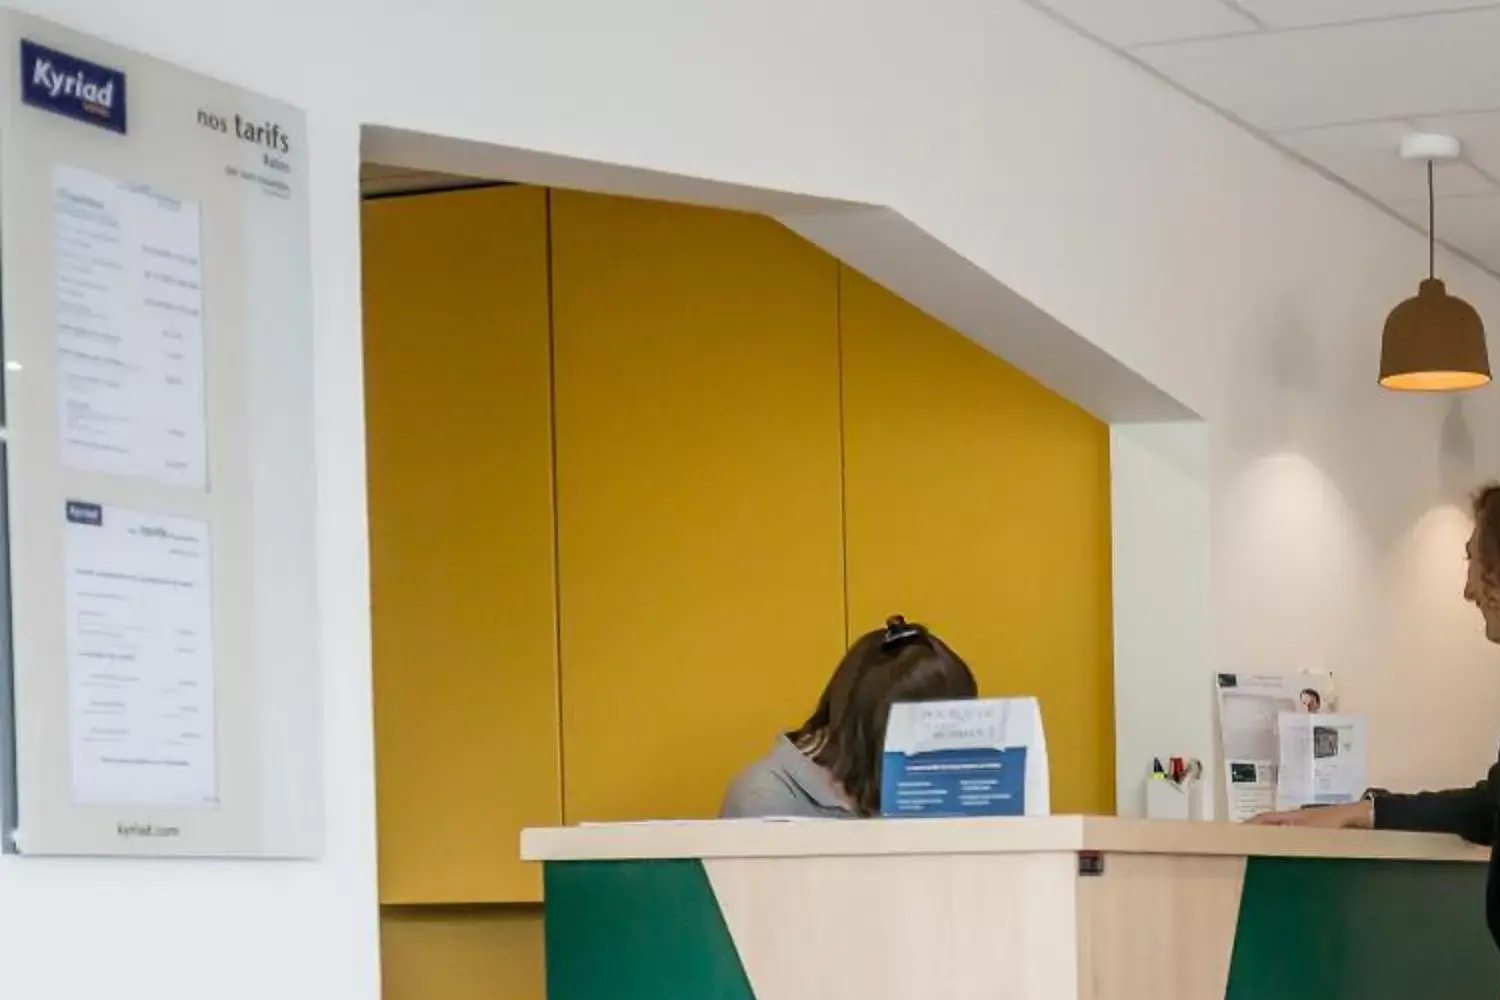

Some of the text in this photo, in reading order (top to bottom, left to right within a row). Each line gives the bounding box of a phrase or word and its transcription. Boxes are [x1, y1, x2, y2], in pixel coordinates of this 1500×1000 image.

[32, 56, 114, 108] Kyriad
[197, 108, 290, 154] nos tarifs
